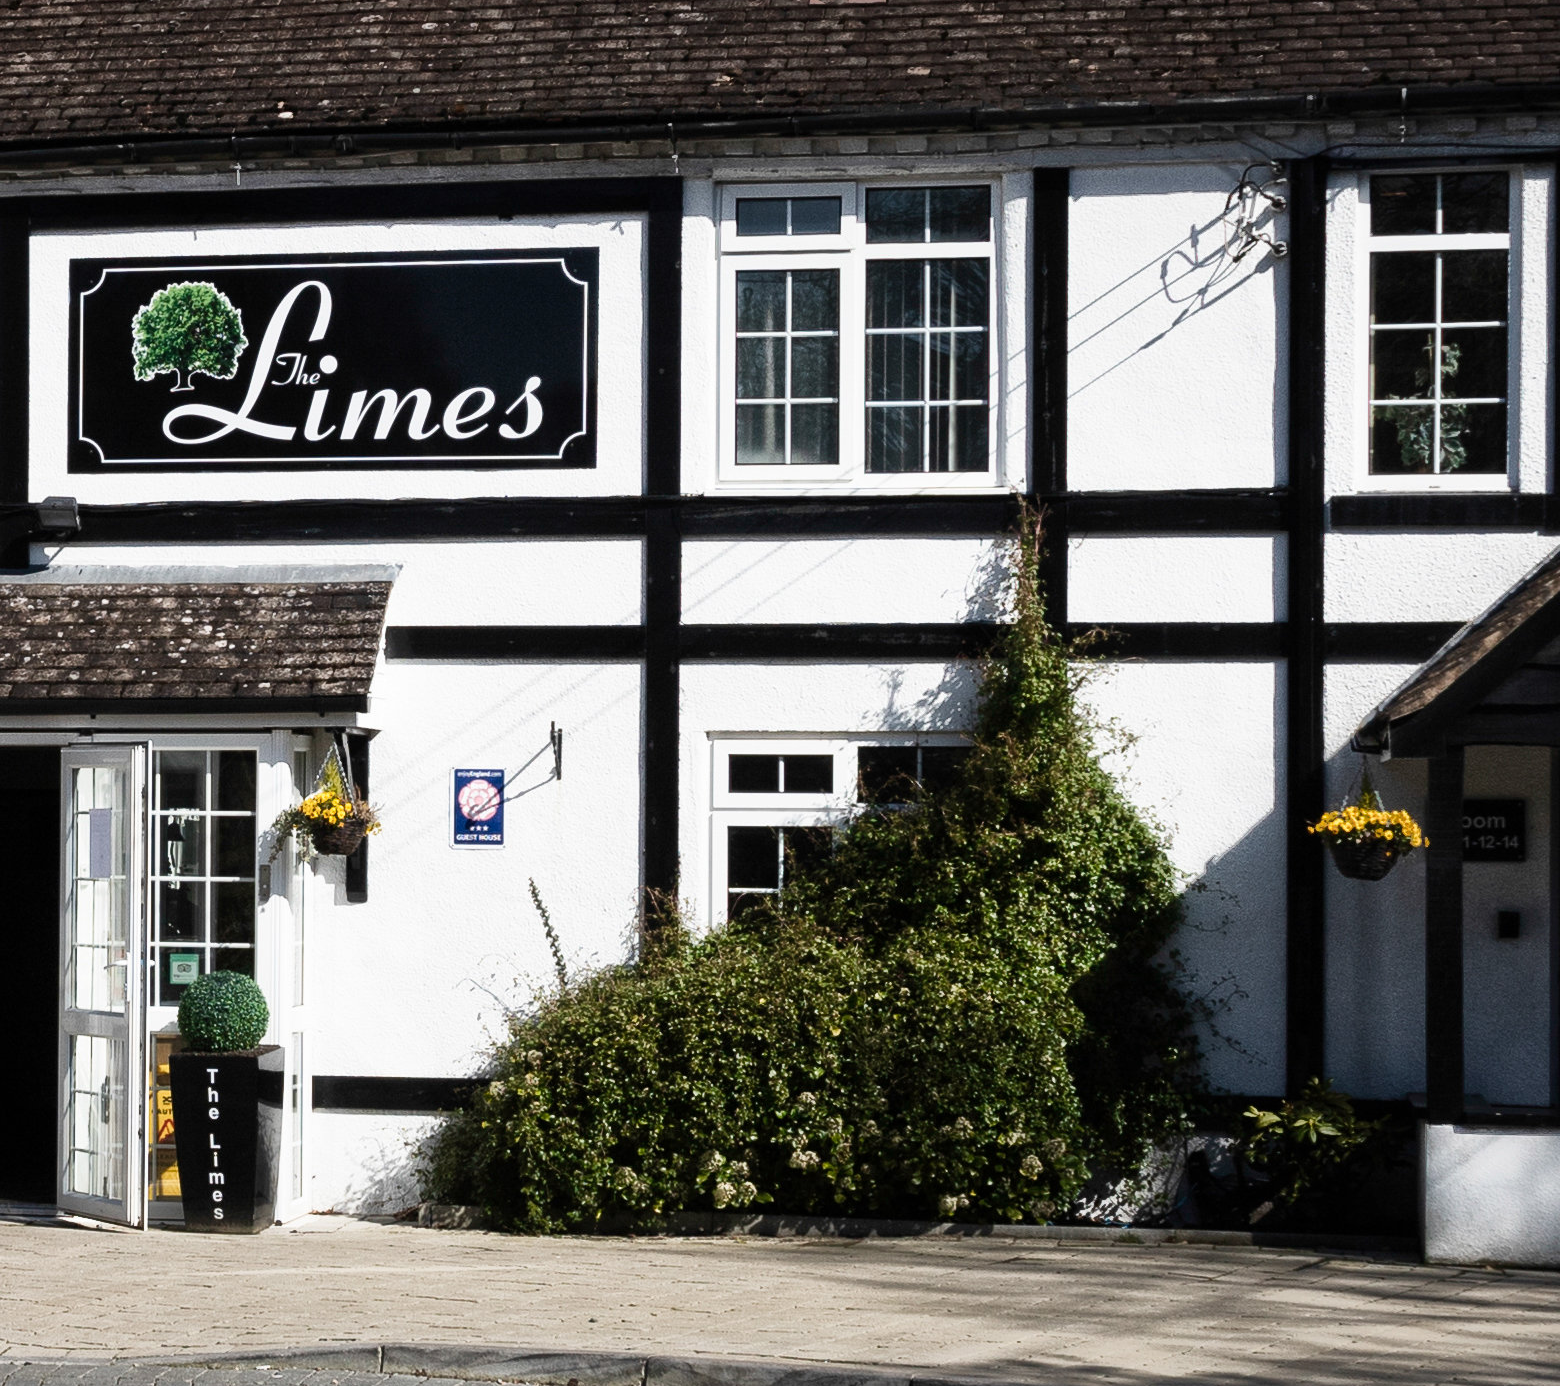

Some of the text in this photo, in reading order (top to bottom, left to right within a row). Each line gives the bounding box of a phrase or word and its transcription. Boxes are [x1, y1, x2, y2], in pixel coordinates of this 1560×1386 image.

[162, 280, 544, 445] The Limes
[1461, 816, 1506, 829] oom
[1462, 835, 1520, 849] 1-12-14
[206, 1068, 225, 1220] The Limes
